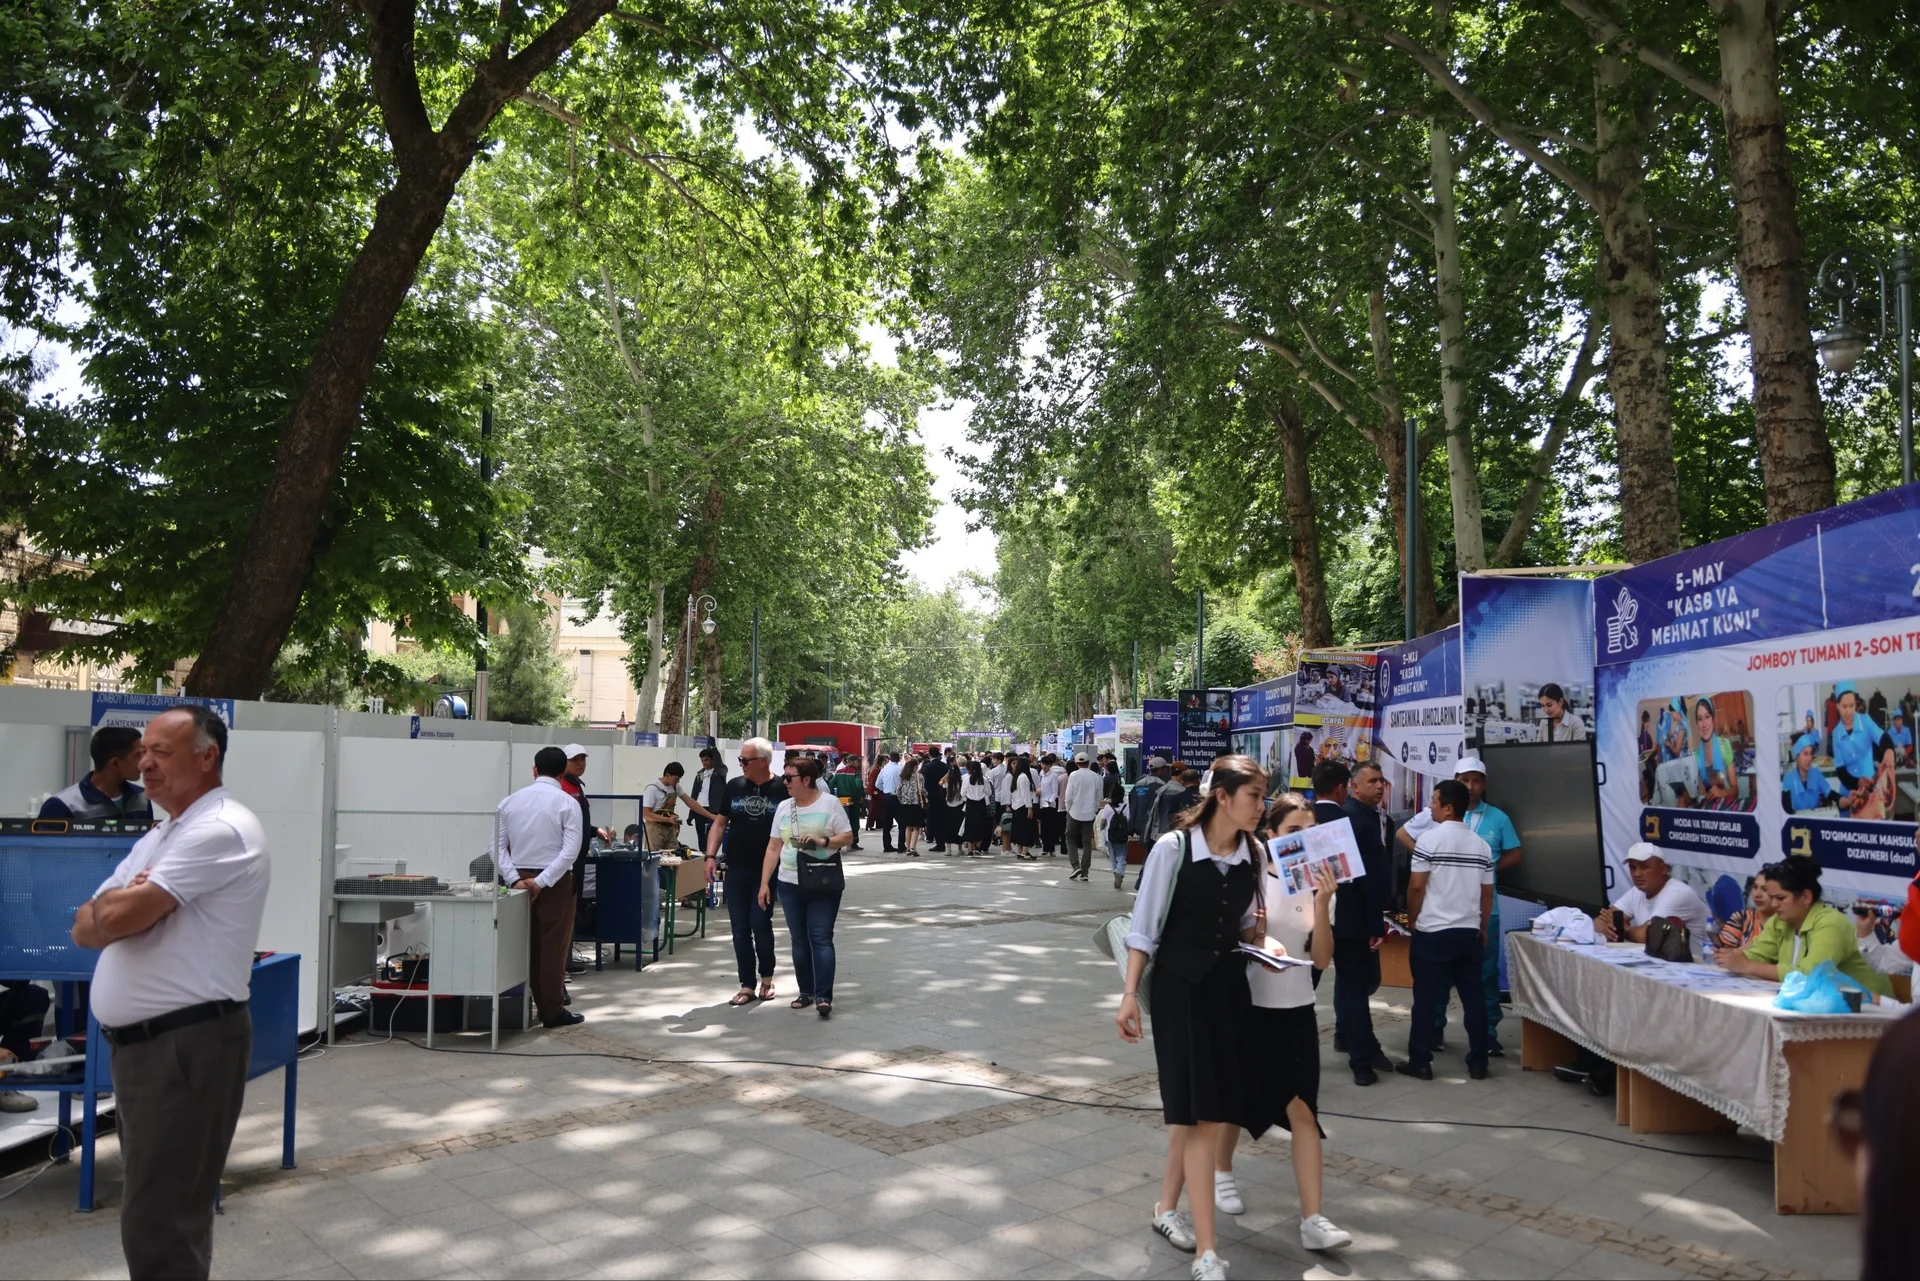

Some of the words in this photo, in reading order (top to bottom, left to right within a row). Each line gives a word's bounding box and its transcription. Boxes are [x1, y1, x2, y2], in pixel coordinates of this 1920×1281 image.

[1676, 561, 1724, 591] 5-MAY
[1716, 585, 1738, 608] VA
[1651, 618, 1709, 646] MEHNAT
[1747, 650, 1797, 671] JOMBOY
[1800, 642, 1851, 664] TUMANI
[1854, 635, 1902, 657] 2-SON
[1391, 709, 1420, 728] SANTEXNIKA
[1673, 817, 1692, 827] MODA
[1692, 819, 1701, 828] VA
[1701, 820, 1719, 830] TIKUV
[1719, 821, 1742, 832] ISHLAB
[1668, 830, 1699, 842] CHIQARISH
[1700, 834, 1749, 848] TEXNOLOGIYASI
[1847, 847, 1889, 862] DIZAYNERI
[1890, 850, 1916, 866] (dual)
